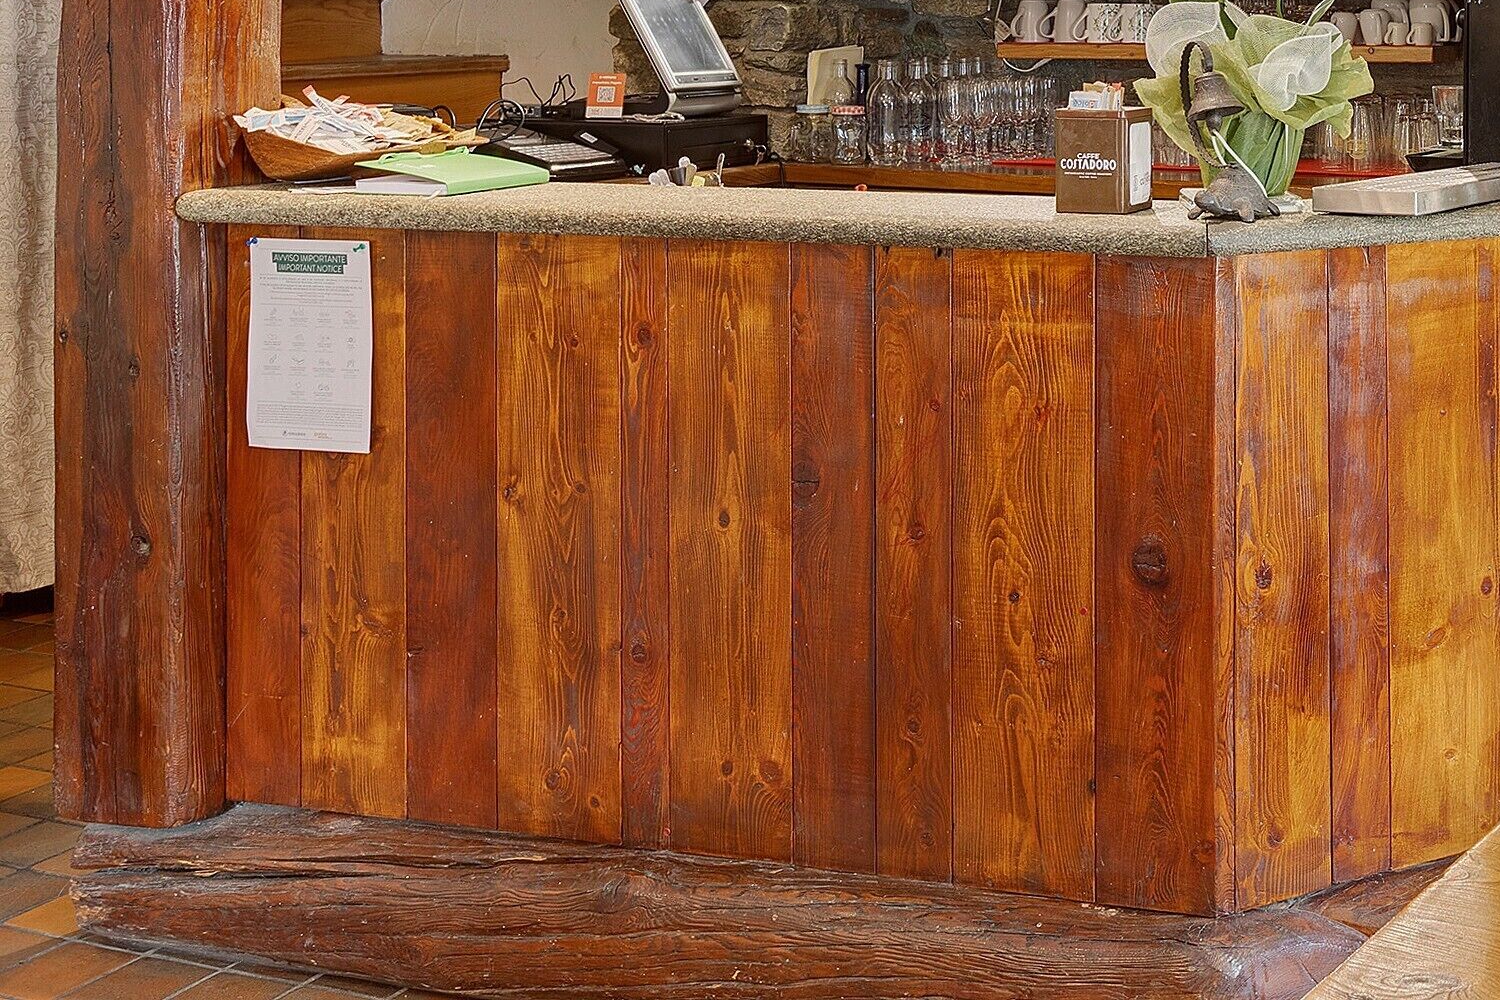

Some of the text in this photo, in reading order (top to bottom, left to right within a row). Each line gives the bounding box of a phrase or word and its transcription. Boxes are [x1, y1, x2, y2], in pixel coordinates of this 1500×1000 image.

[1060, 158, 1116, 170] COSTADORO
[273, 254, 346, 263] AVVISO IMPORTANTE
